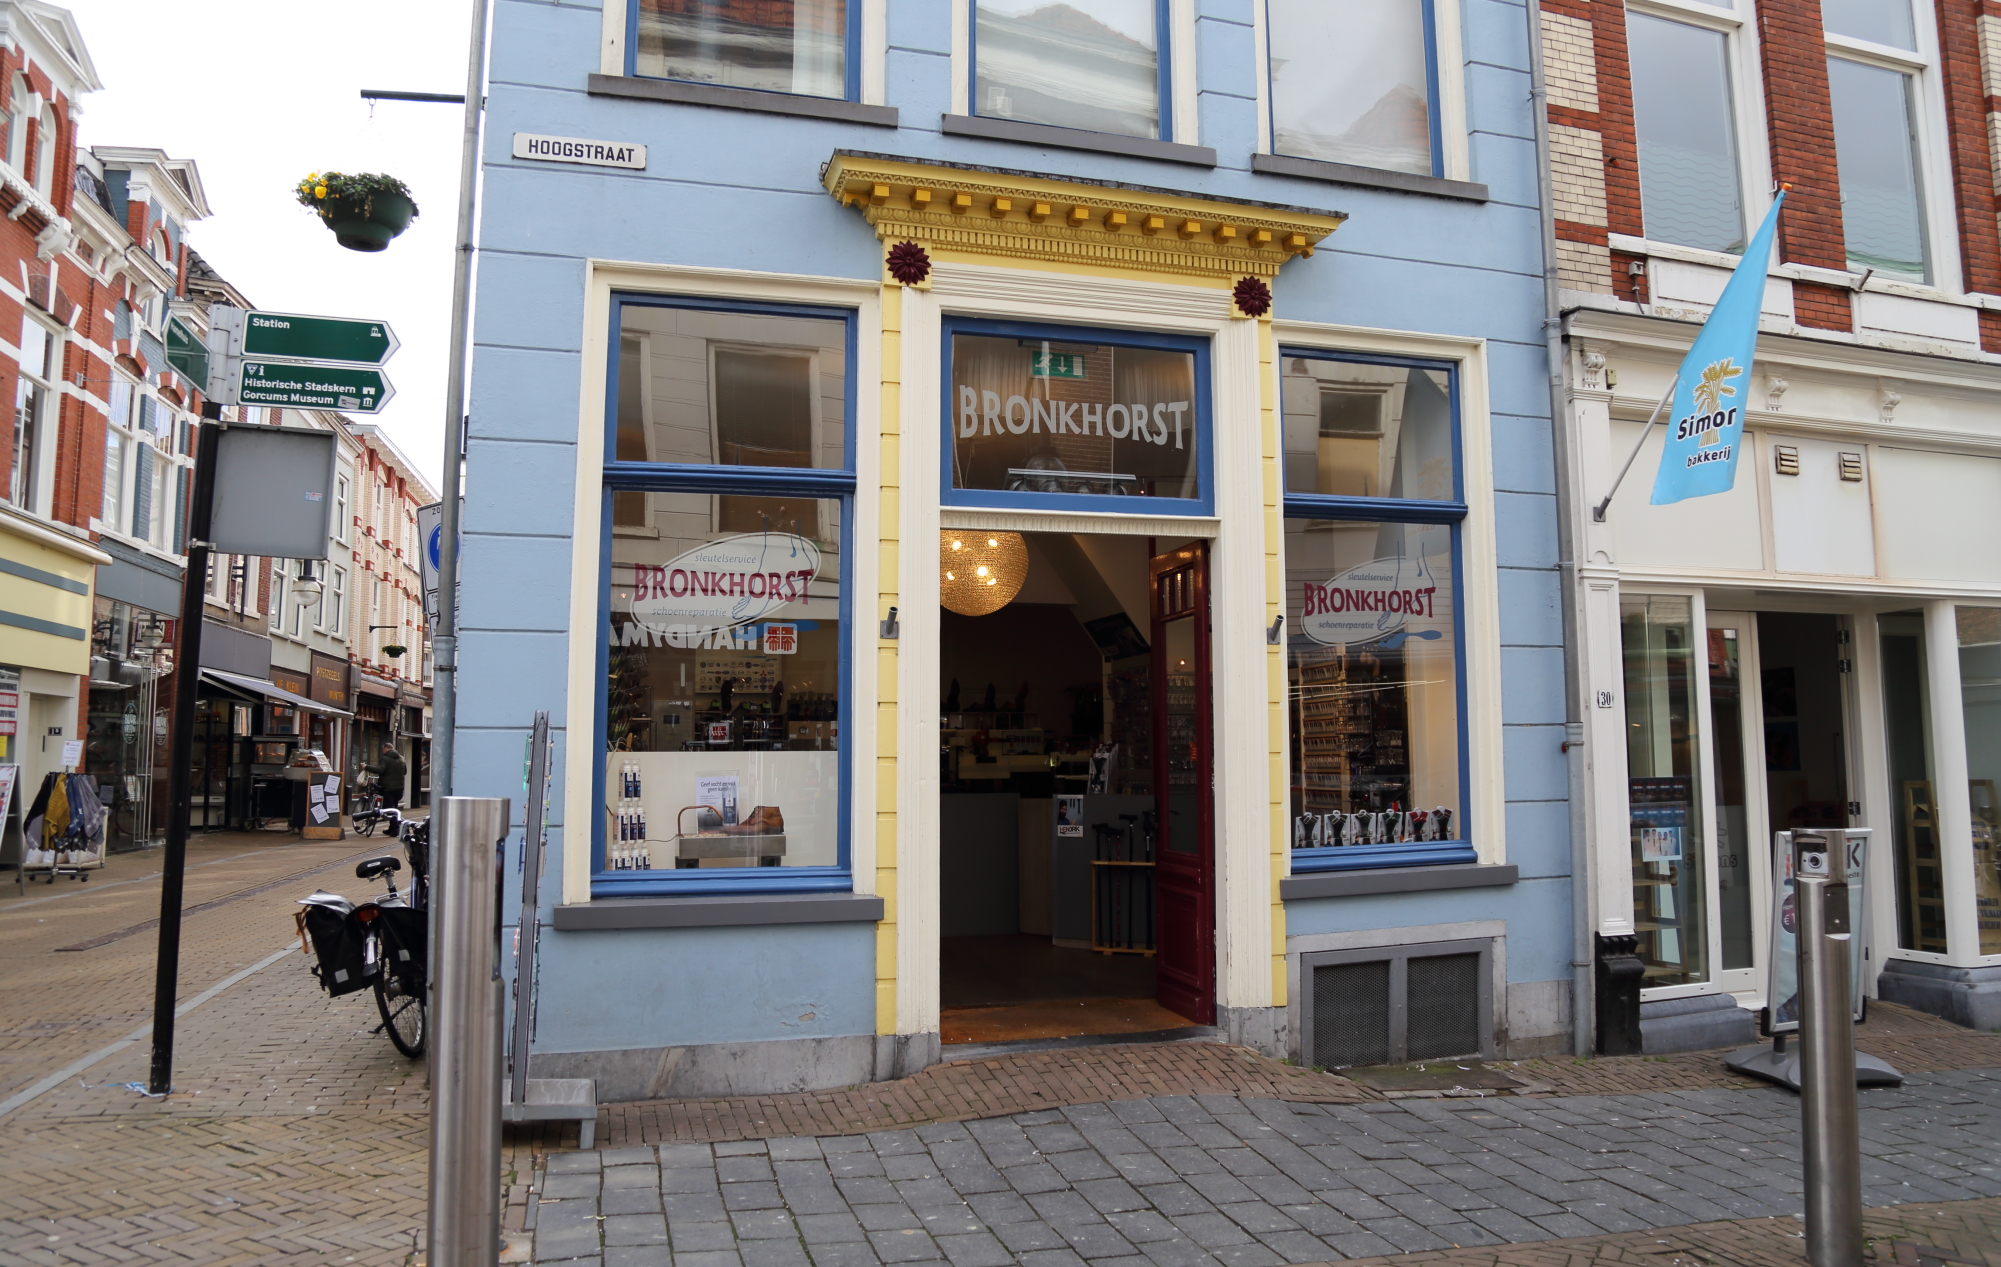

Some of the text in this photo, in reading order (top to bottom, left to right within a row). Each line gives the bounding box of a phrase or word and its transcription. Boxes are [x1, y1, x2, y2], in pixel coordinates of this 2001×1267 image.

[529, 139, 635, 163] HOOGSTRAAT
[253, 317, 290, 329] Station
[244, 378, 356, 394] Historische Stadskern
[243, 390, 289, 403] Gorcums
[290, 393, 334, 405] Museum
[959, 384, 1189, 450] BRONKHORST
[1687, 446, 1731, 468] bakkerij
[695, 553, 757, 564] sleutelservice
[634, 562, 815, 605] BRONKHORST
[1347, 572, 1394, 582] sleutelservice
[1303, 582, 1436, 618] BRONKHORST
[651, 606, 727, 618] schoenreparatie
[1318, 620, 1375, 630] schoenreparatie
[1601, 691, 1612, 706] 30
